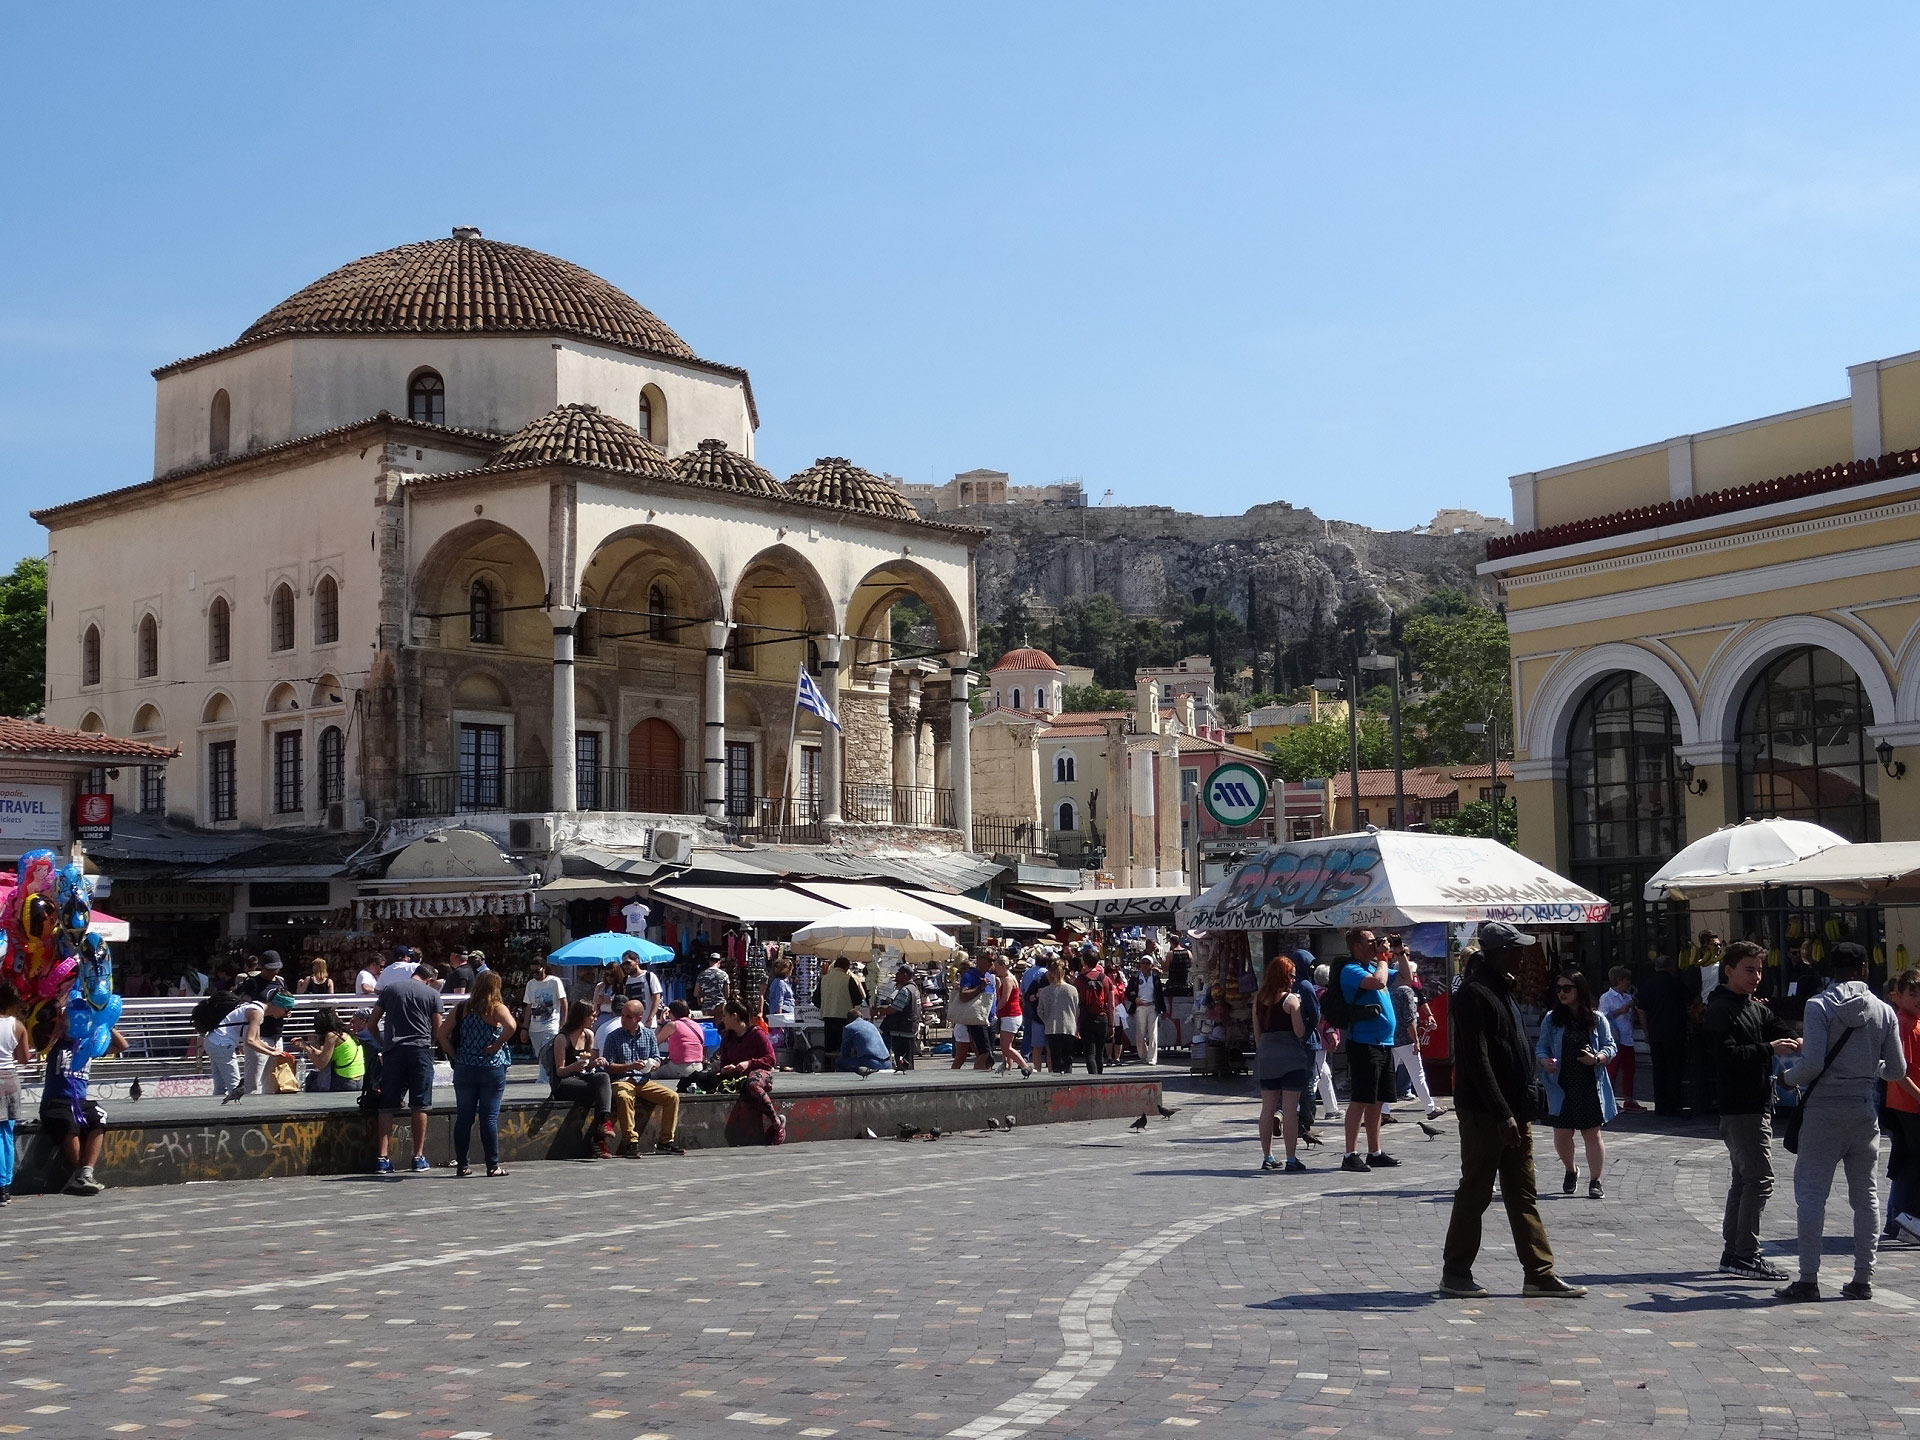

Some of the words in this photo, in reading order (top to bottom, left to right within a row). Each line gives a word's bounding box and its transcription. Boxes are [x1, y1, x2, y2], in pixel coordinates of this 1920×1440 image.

[0, 799, 46, 814] TRAVEL
[123, 890, 135, 905] in
[139, 889, 158, 905] the
[160, 890, 179, 905] old
[182, 890, 226, 907] mosque
